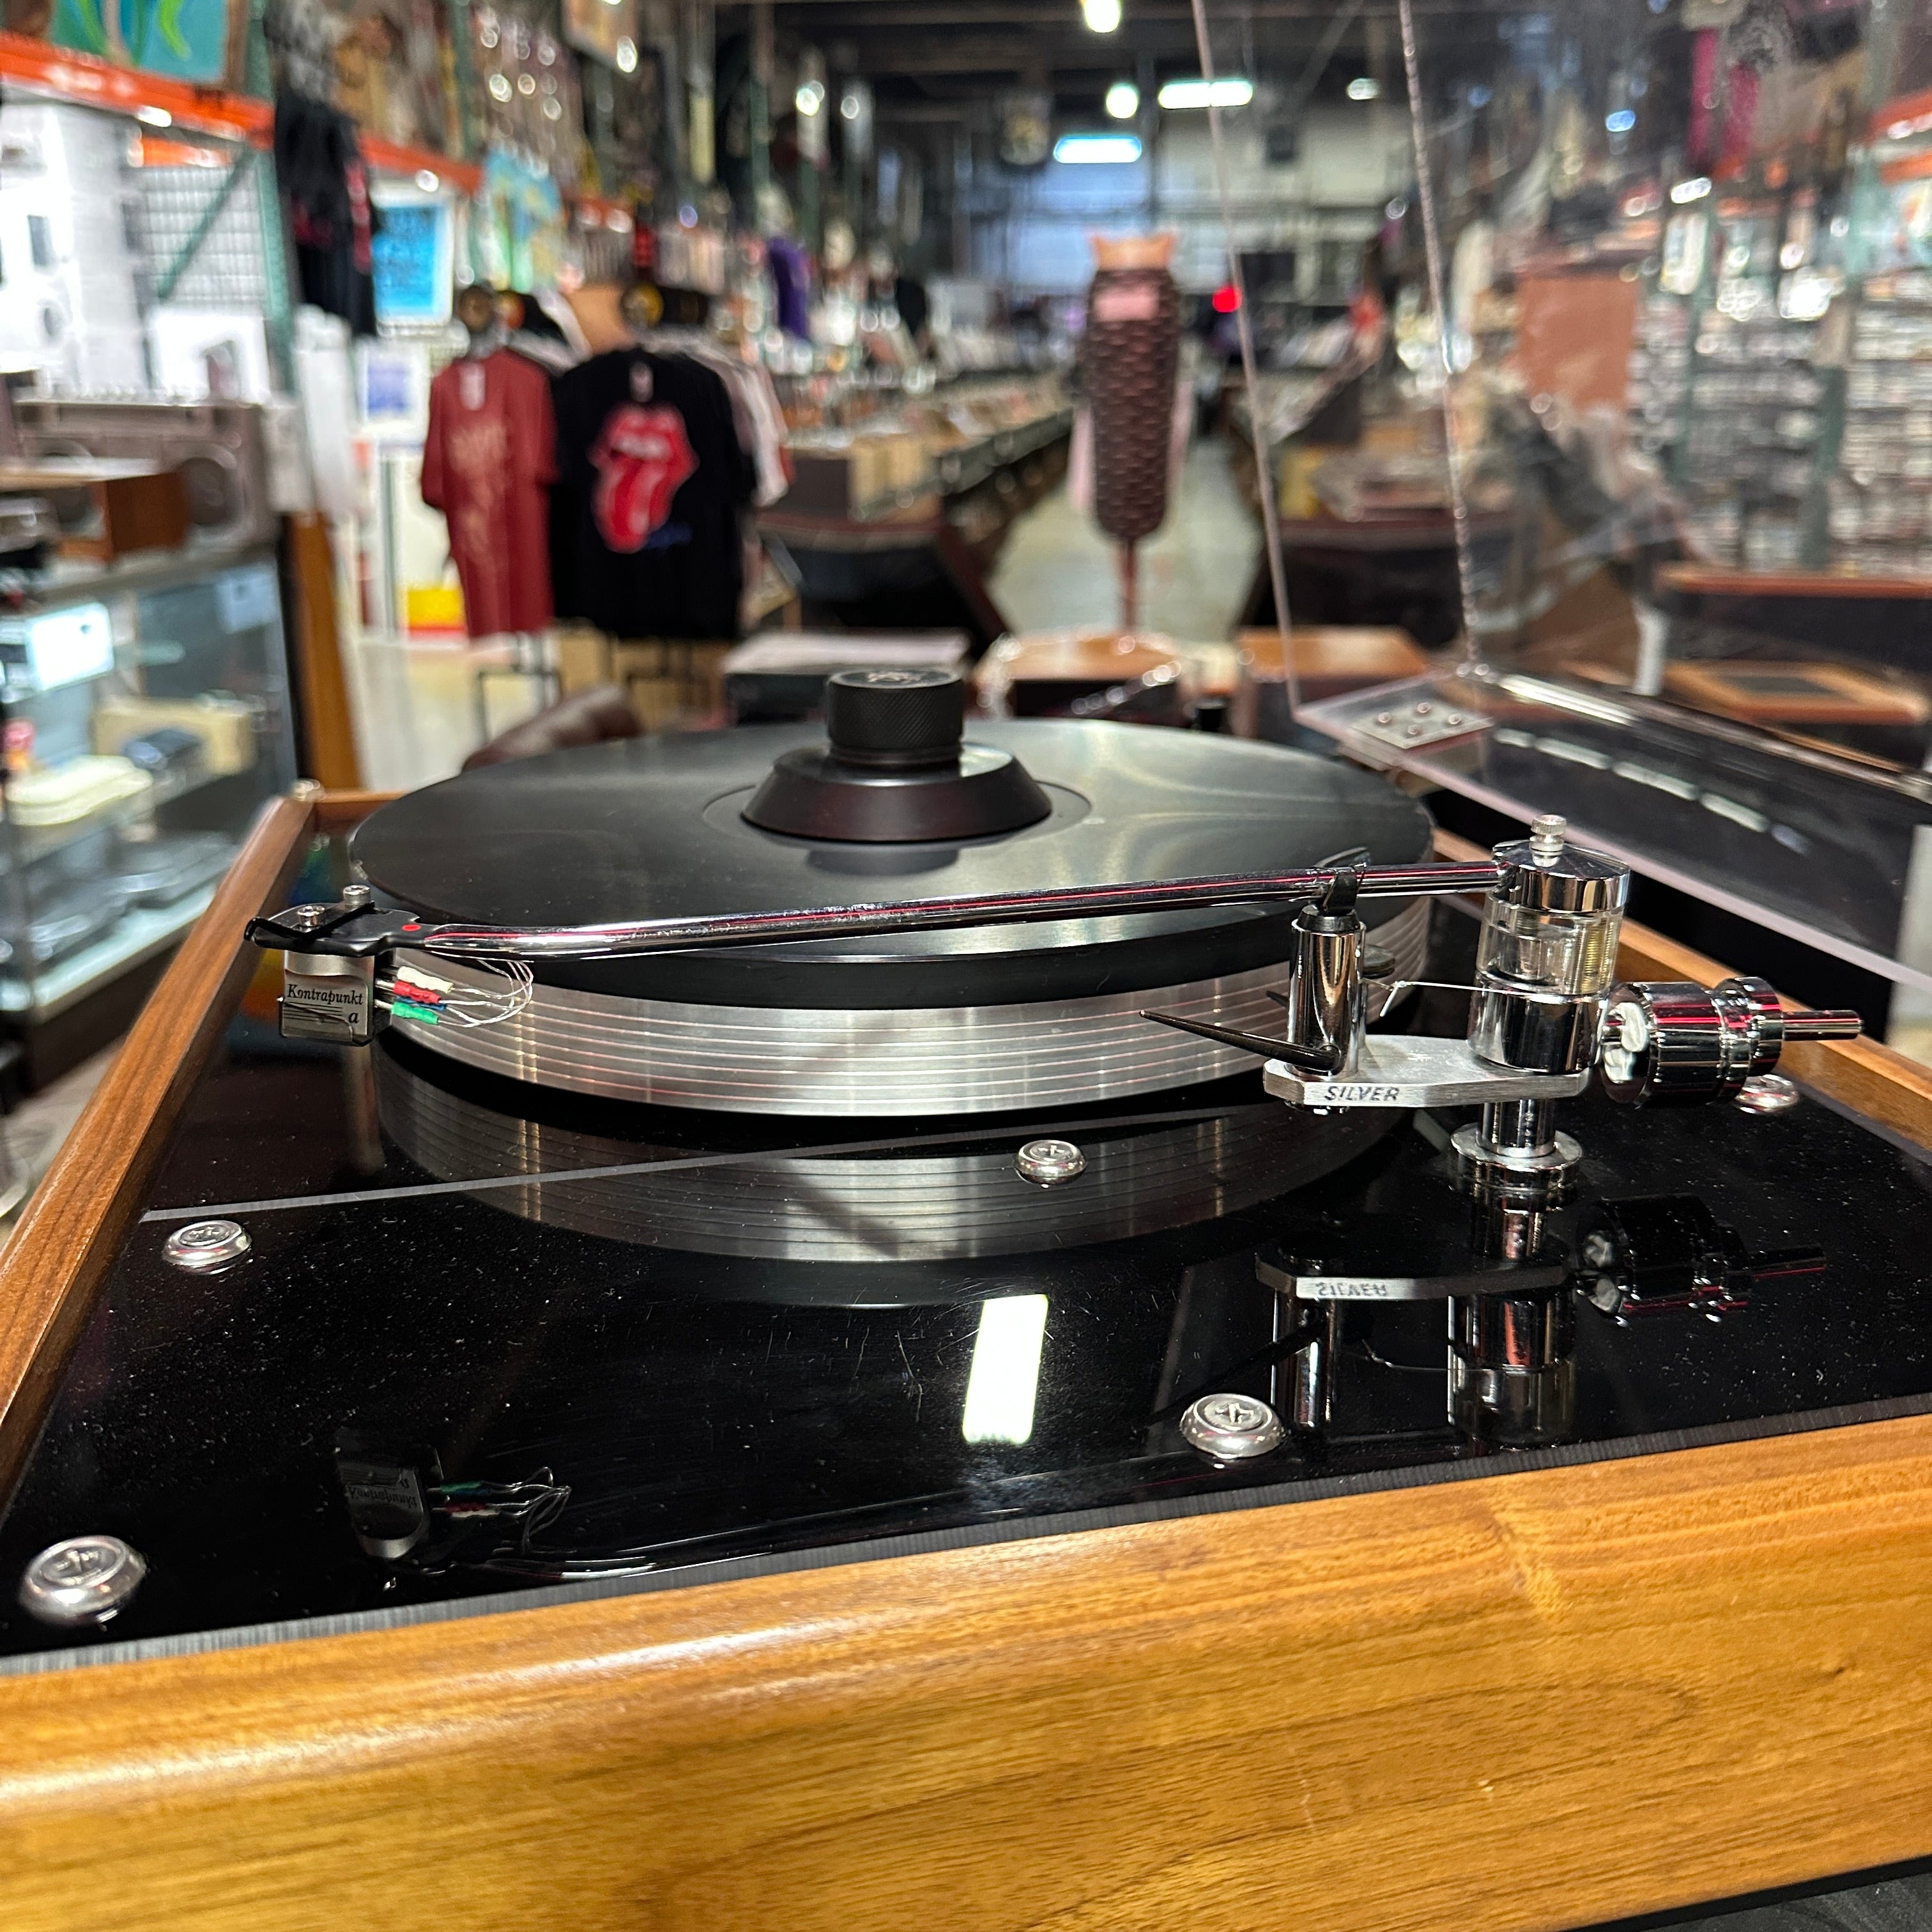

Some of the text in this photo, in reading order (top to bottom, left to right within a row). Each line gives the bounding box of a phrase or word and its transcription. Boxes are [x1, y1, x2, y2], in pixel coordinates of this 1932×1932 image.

[287, 984, 364, 1006] Kontrapunkt
[348, 1012, 358, 1023] a
[1324, 1086, 1400, 1101] SILVER
